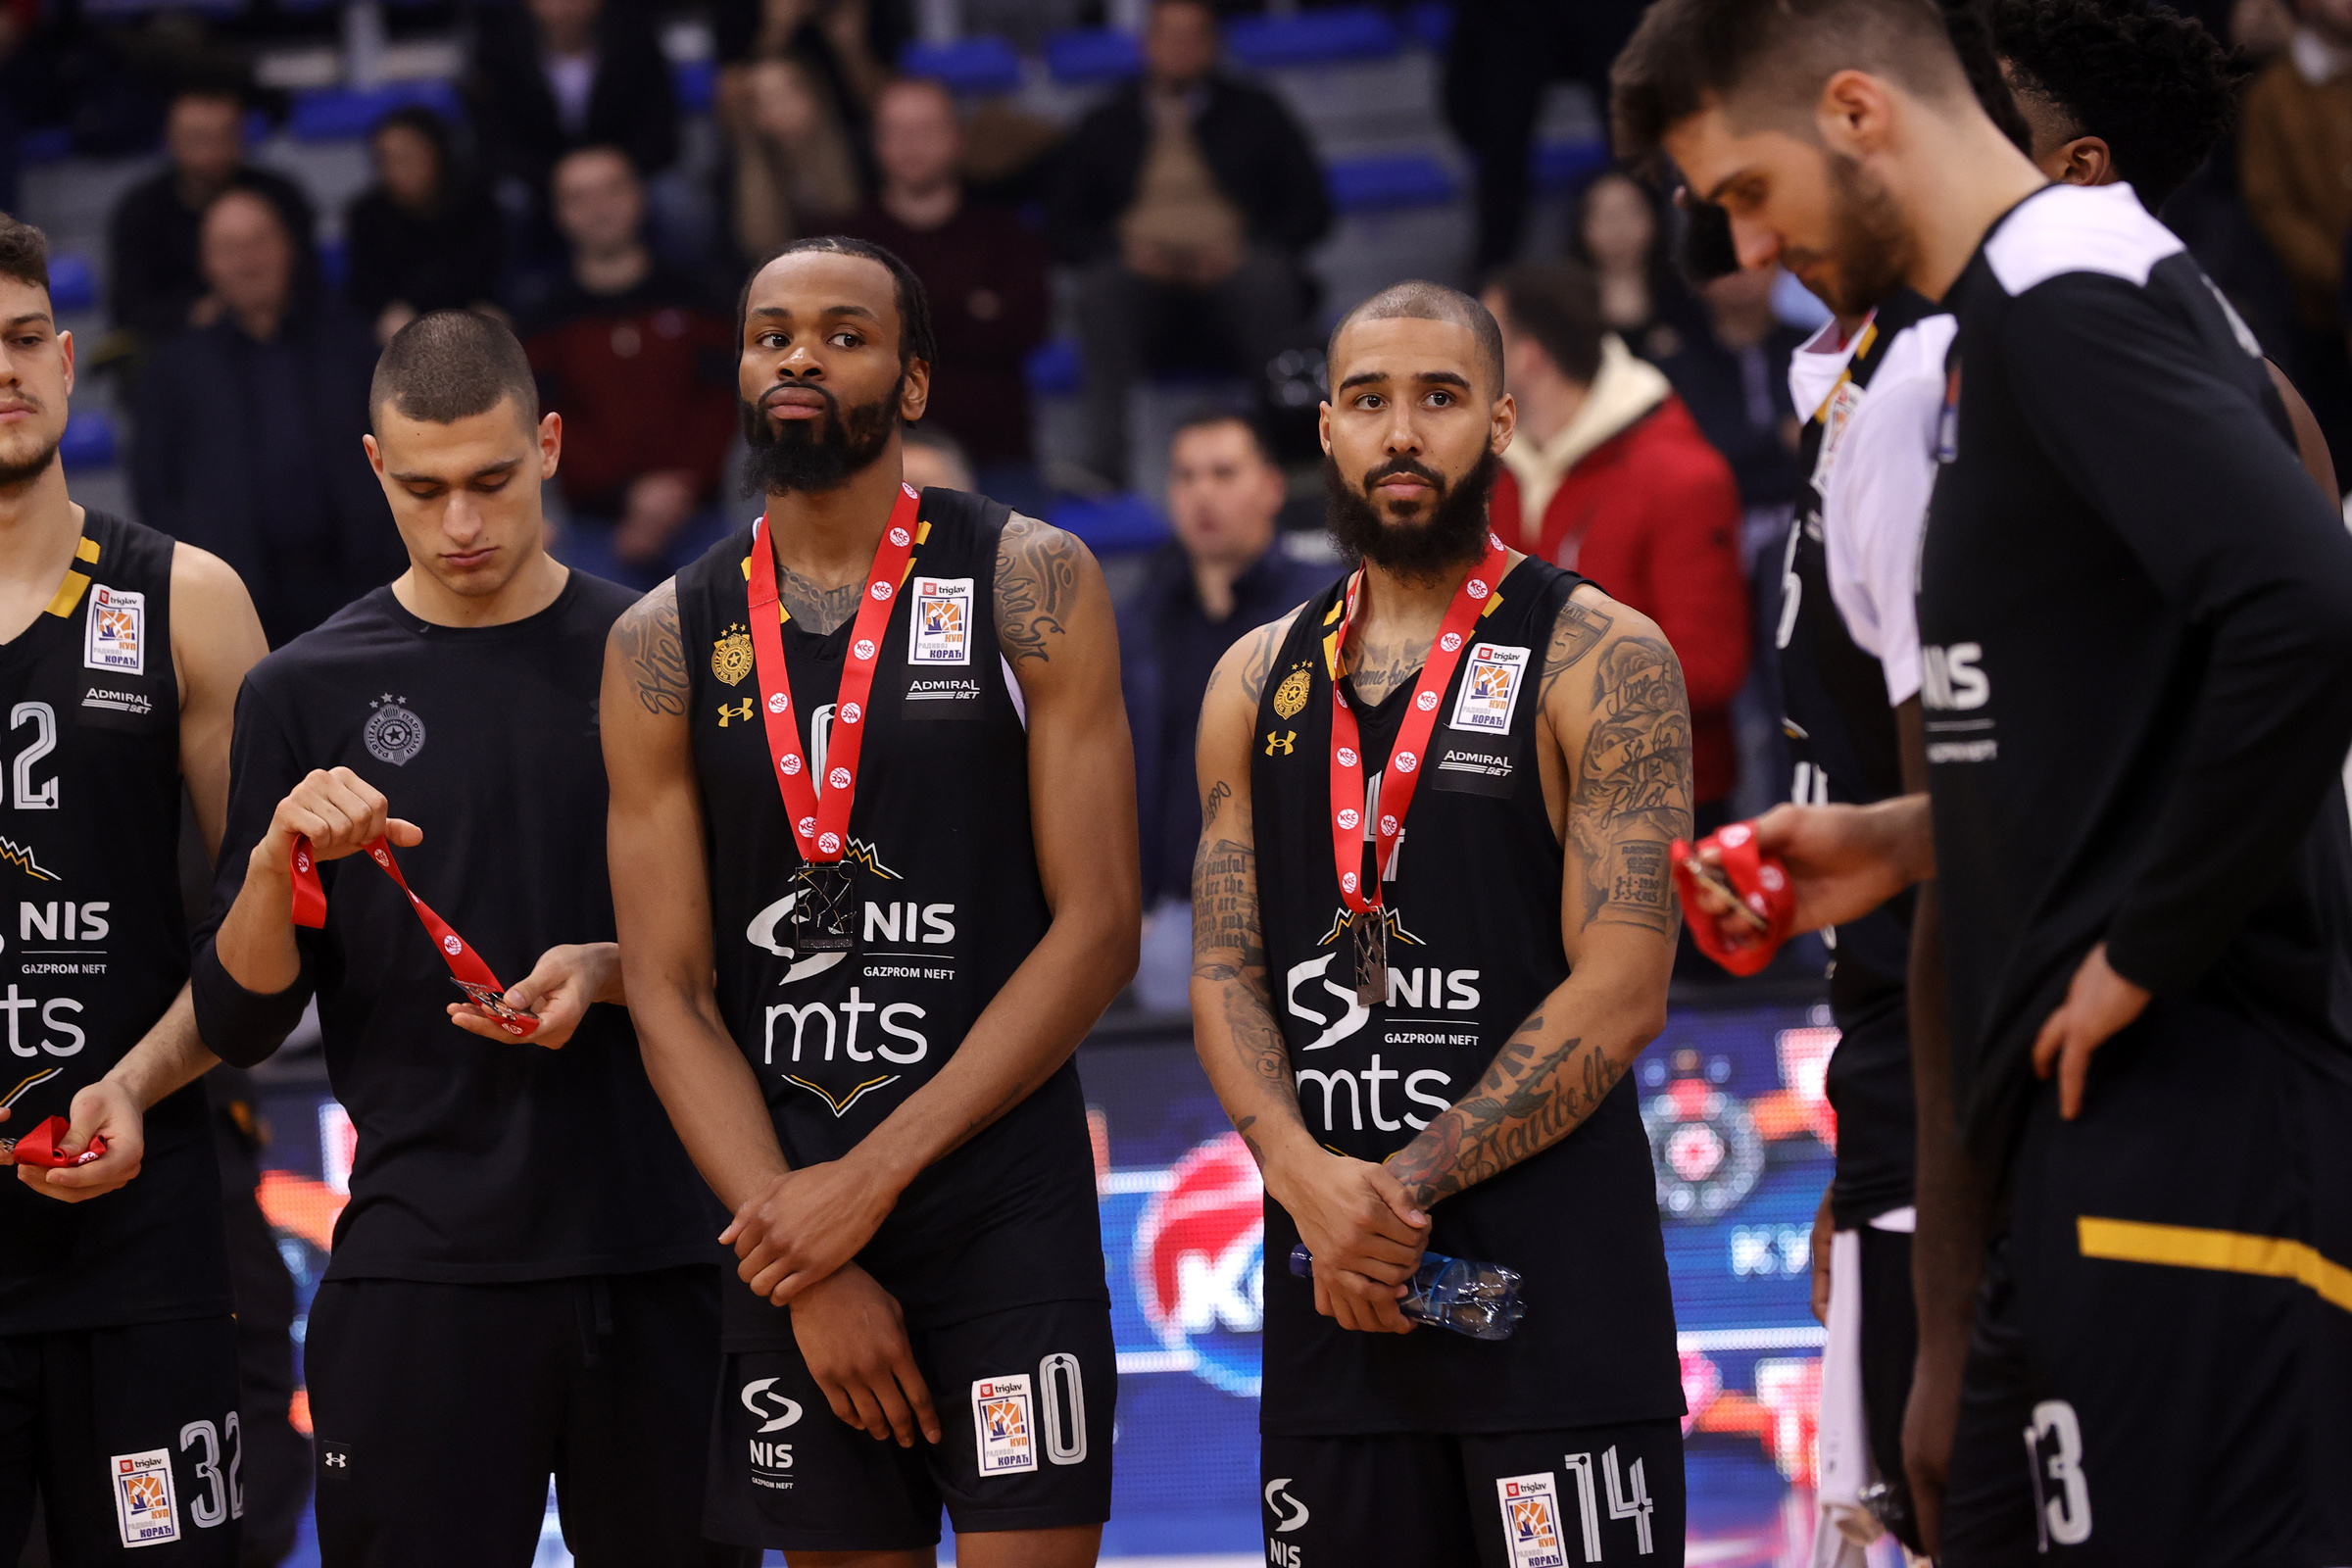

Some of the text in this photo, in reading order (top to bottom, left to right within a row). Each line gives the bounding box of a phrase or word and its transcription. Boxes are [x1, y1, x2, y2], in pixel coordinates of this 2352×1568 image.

[939, 586, 966, 596] triglav
[110, 597, 137, 606] triglav
[945, 634, 963, 643] КУП
[119, 642, 136, 651] КУП
[929, 649, 962, 659] КОРАЋ
[1494, 651, 1520, 662] triglav
[104, 655, 136, 666] КОРАЋ
[909, 679, 980, 692] ADMIRAL
[86, 688, 152, 707] ADMIRAL
[956, 691, 980, 700] BET
[128, 705, 152, 714] BET
[1489, 700, 1507, 710] КУП
[1472, 714, 1502, 726] КОРАЋ
[1444, 750, 1513, 768] ADMIRAL
[1486, 766, 1512, 777] BET
[20, 901, 110, 941] NIS
[863, 901, 956, 944] NIS
[22, 963, 108, 975] GAZPROM NEFT
[863, 966, 956, 980] GAZPROM NEFT
[1385, 966, 1481, 1010] NIS
[764, 986, 927, 1064] mts
[1384, 1032, 1480, 1047] GAZPROM NEFT
[1296, 1054, 1452, 1131] mts
[995, 1383, 1022, 1394] triglav
[1039, 1353, 1087, 1465] 0
[1010, 1437, 1027, 1447] КУП
[750, 1439, 794, 1468] NIS
[135, 1458, 162, 1469] triglav
[998, 1454, 1029, 1466] КОРАЋ
[179, 1410, 244, 1529] 32
[752, 1477, 775, 1489] GAZPROM
[1520, 1482, 1547, 1494] triglav
[1564, 1445, 1654, 1563] 14
[151, 1508, 170, 1520] КУП
[140, 1525, 172, 1539] КОРАЋ
[1539, 1538, 1556, 1548] КУП
[1270, 1538, 1301, 1568] NIS
[1529, 1554, 1560, 1568] КОРАЋ
